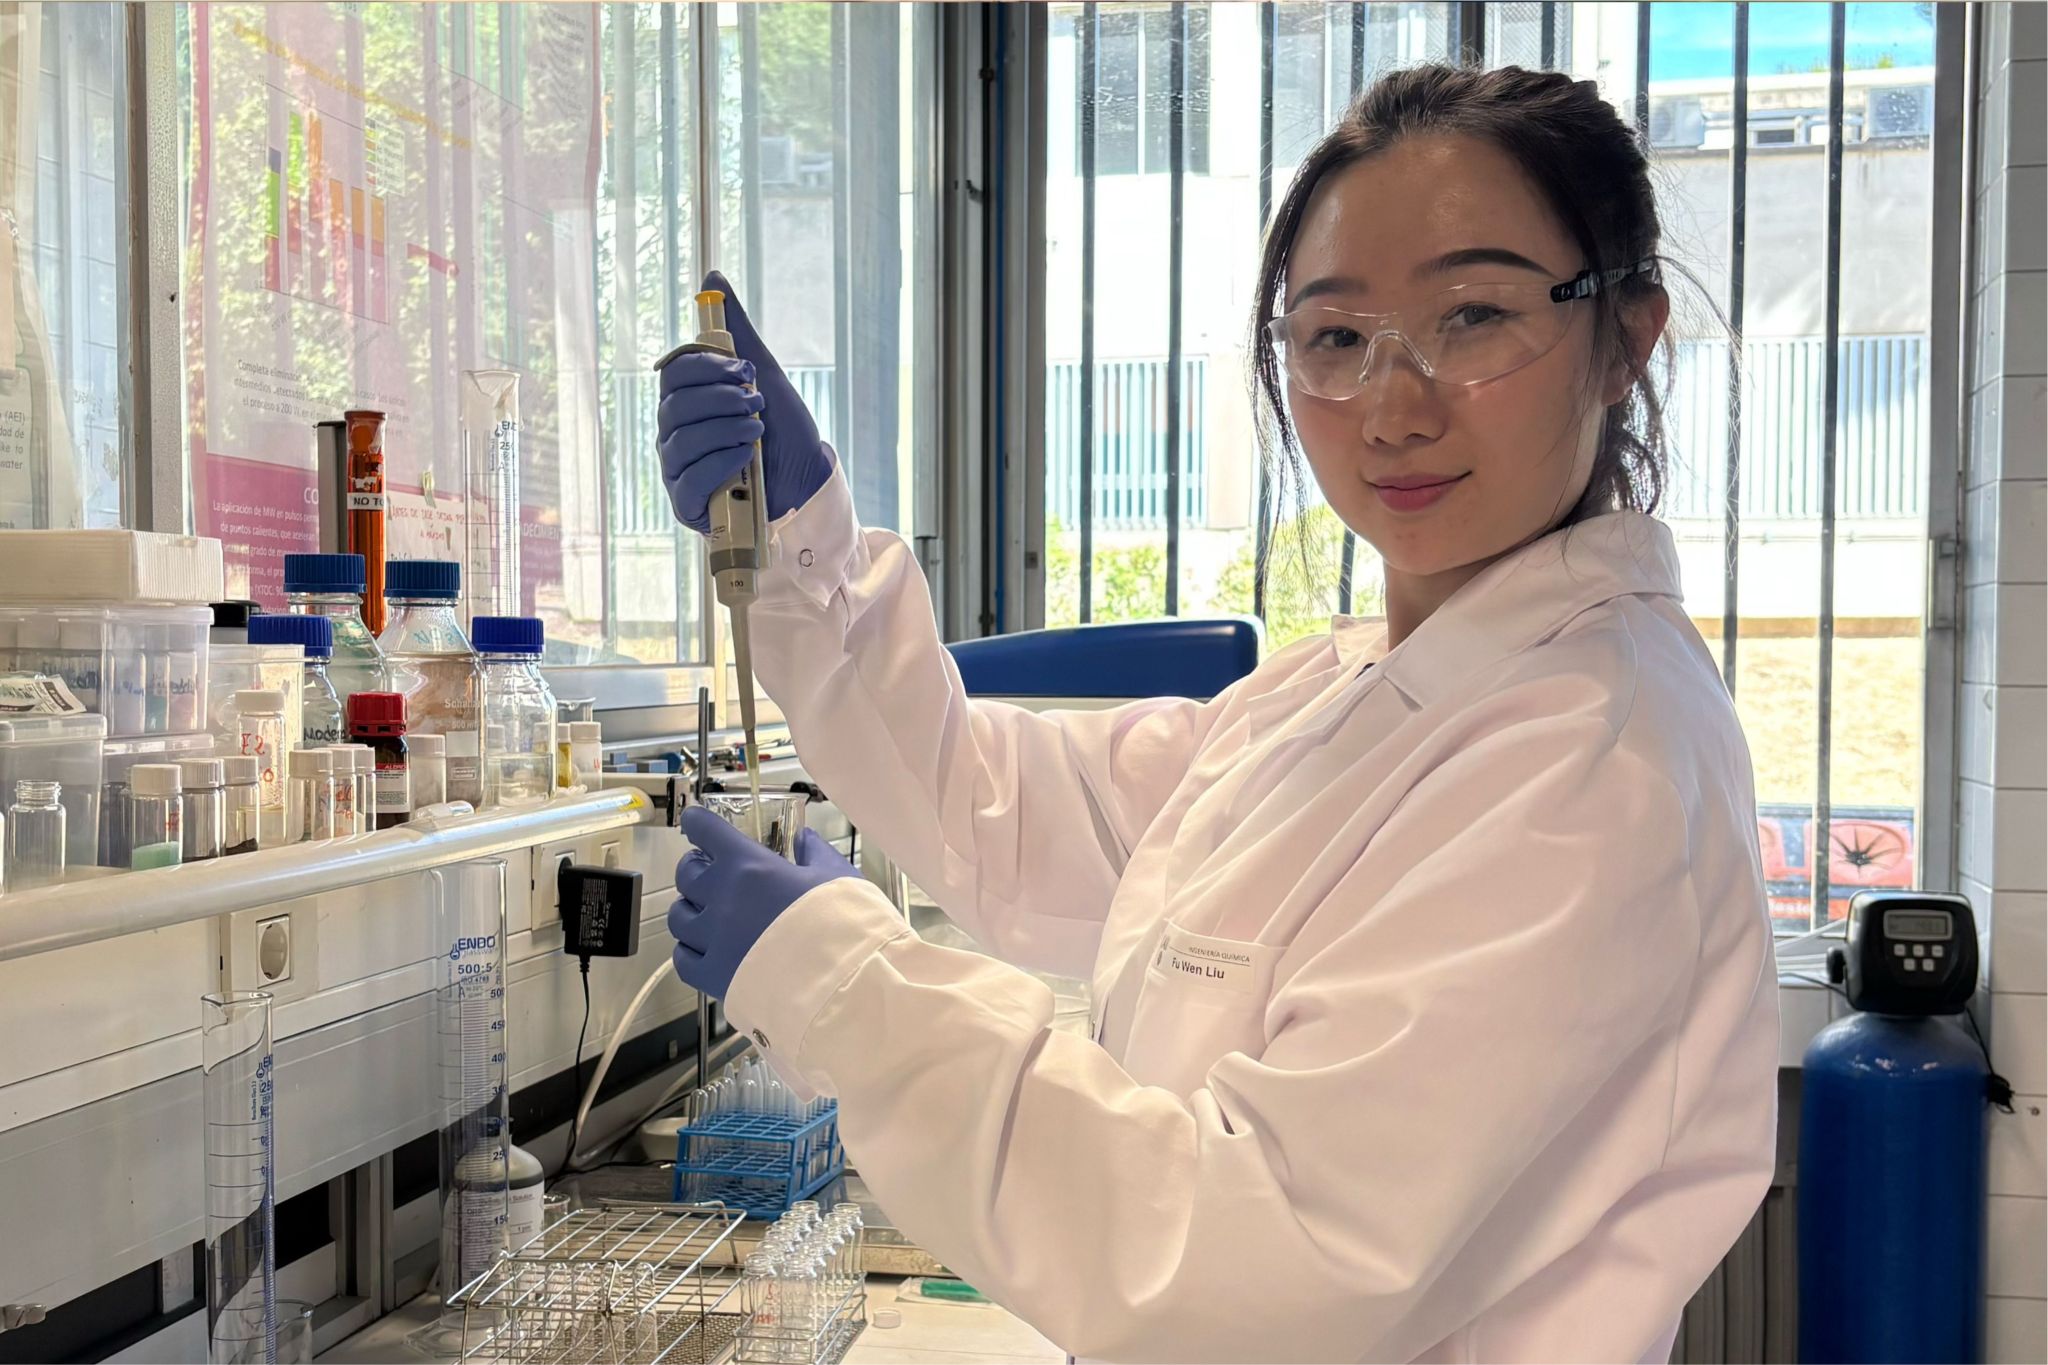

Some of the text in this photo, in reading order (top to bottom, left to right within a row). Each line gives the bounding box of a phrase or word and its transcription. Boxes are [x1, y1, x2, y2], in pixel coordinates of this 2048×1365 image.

[237, 359, 270, 377] Completa
[234, 377, 272, 395] ntermedios
[249, 399, 276, 413] proceso
[280, 403, 294, 416] 200
[5, 410, 25, 425] (AEI)
[14, 430, 24, 439] de
[15, 444, 23, 454] to
[353, 497, 370, 506] NO
[212, 499, 222, 512] La
[221, 502, 254, 516] aplicación
[254, 506, 262, 516] de
[262, 506, 276, 518] MW
[276, 510, 284, 520] en
[284, 510, 303, 521] pulsos
[220, 521, 229, 533] de
[229, 523, 252, 536] puntos
[252, 526, 279, 538] calientes,
[279, 530, 292, 540] que
[250, 546, 268, 557] grado
[268, 548, 277, 557] de
[266, 568, 273, 577] el
[730, 580, 744, 588] 100
[458, 935, 496, 951] ENDO
[458, 962, 493, 975] 500:5
[1181, 960, 1203, 976] Wen
[1205, 965, 1225, 980] Liu
[458, 983, 466, 999] A
